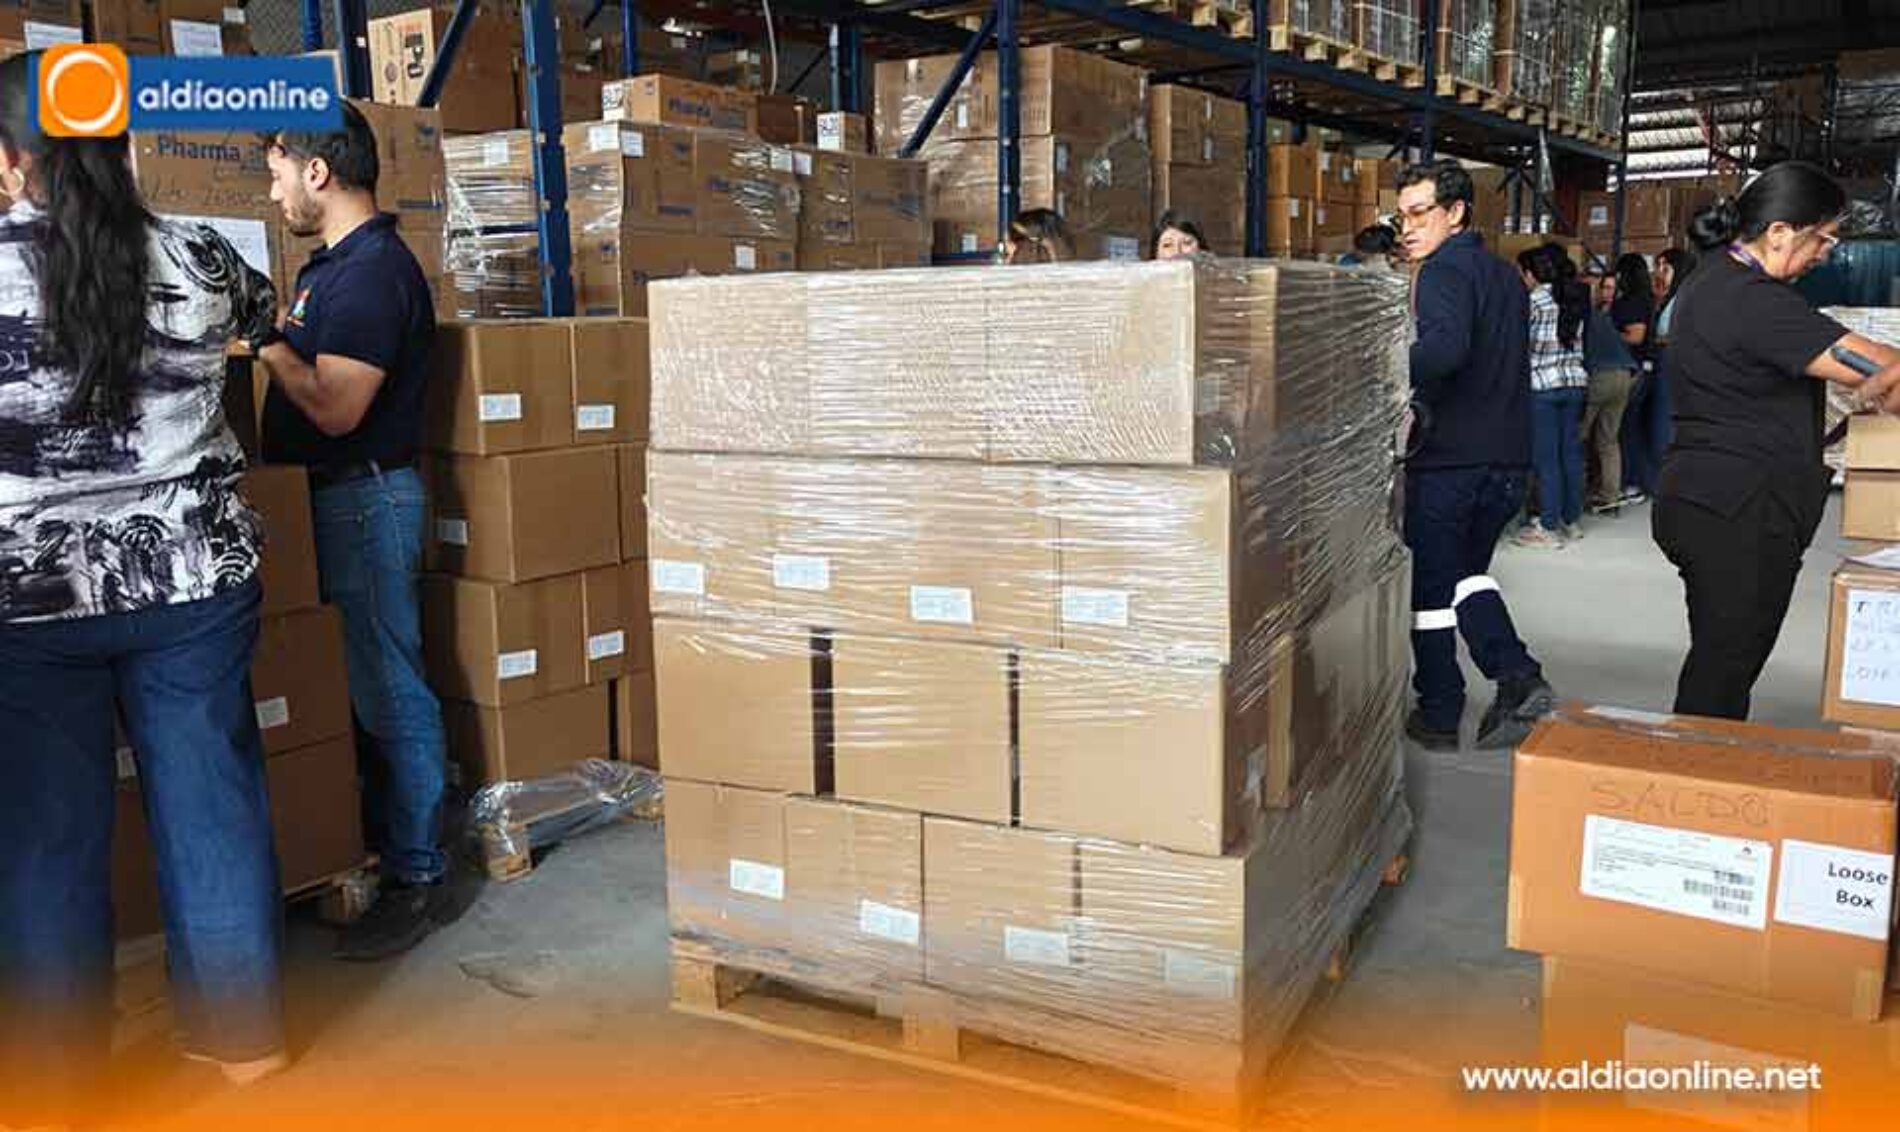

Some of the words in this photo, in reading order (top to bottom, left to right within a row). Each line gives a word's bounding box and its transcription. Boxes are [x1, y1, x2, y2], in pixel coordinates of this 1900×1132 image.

[157, 134, 240, 161] Pharma
[1589, 780, 1769, 827] SALDO
[1827, 861, 1889, 886] Loose
[1835, 888, 1877, 910] Box
